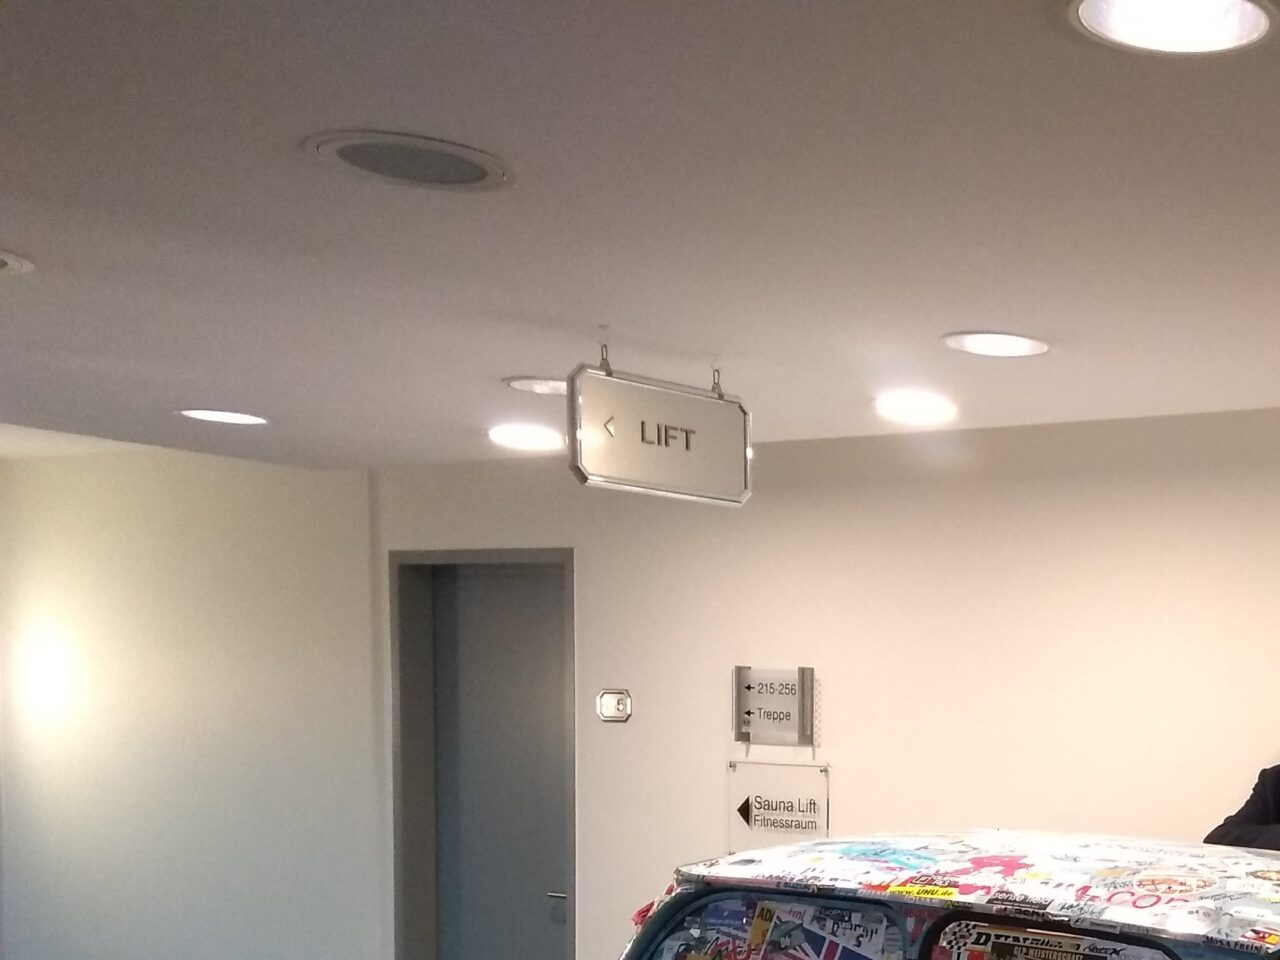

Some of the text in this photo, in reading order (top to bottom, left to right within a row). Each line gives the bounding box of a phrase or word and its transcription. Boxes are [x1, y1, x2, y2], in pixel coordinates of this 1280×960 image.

[640, 420, 696, 451] LIFT
[757, 682, 797, 696] 215-256
[757, 708, 791, 722] Treppe
[753, 795, 818, 815] Sauna Lift
[753, 814, 818, 831] Fitnessraum
